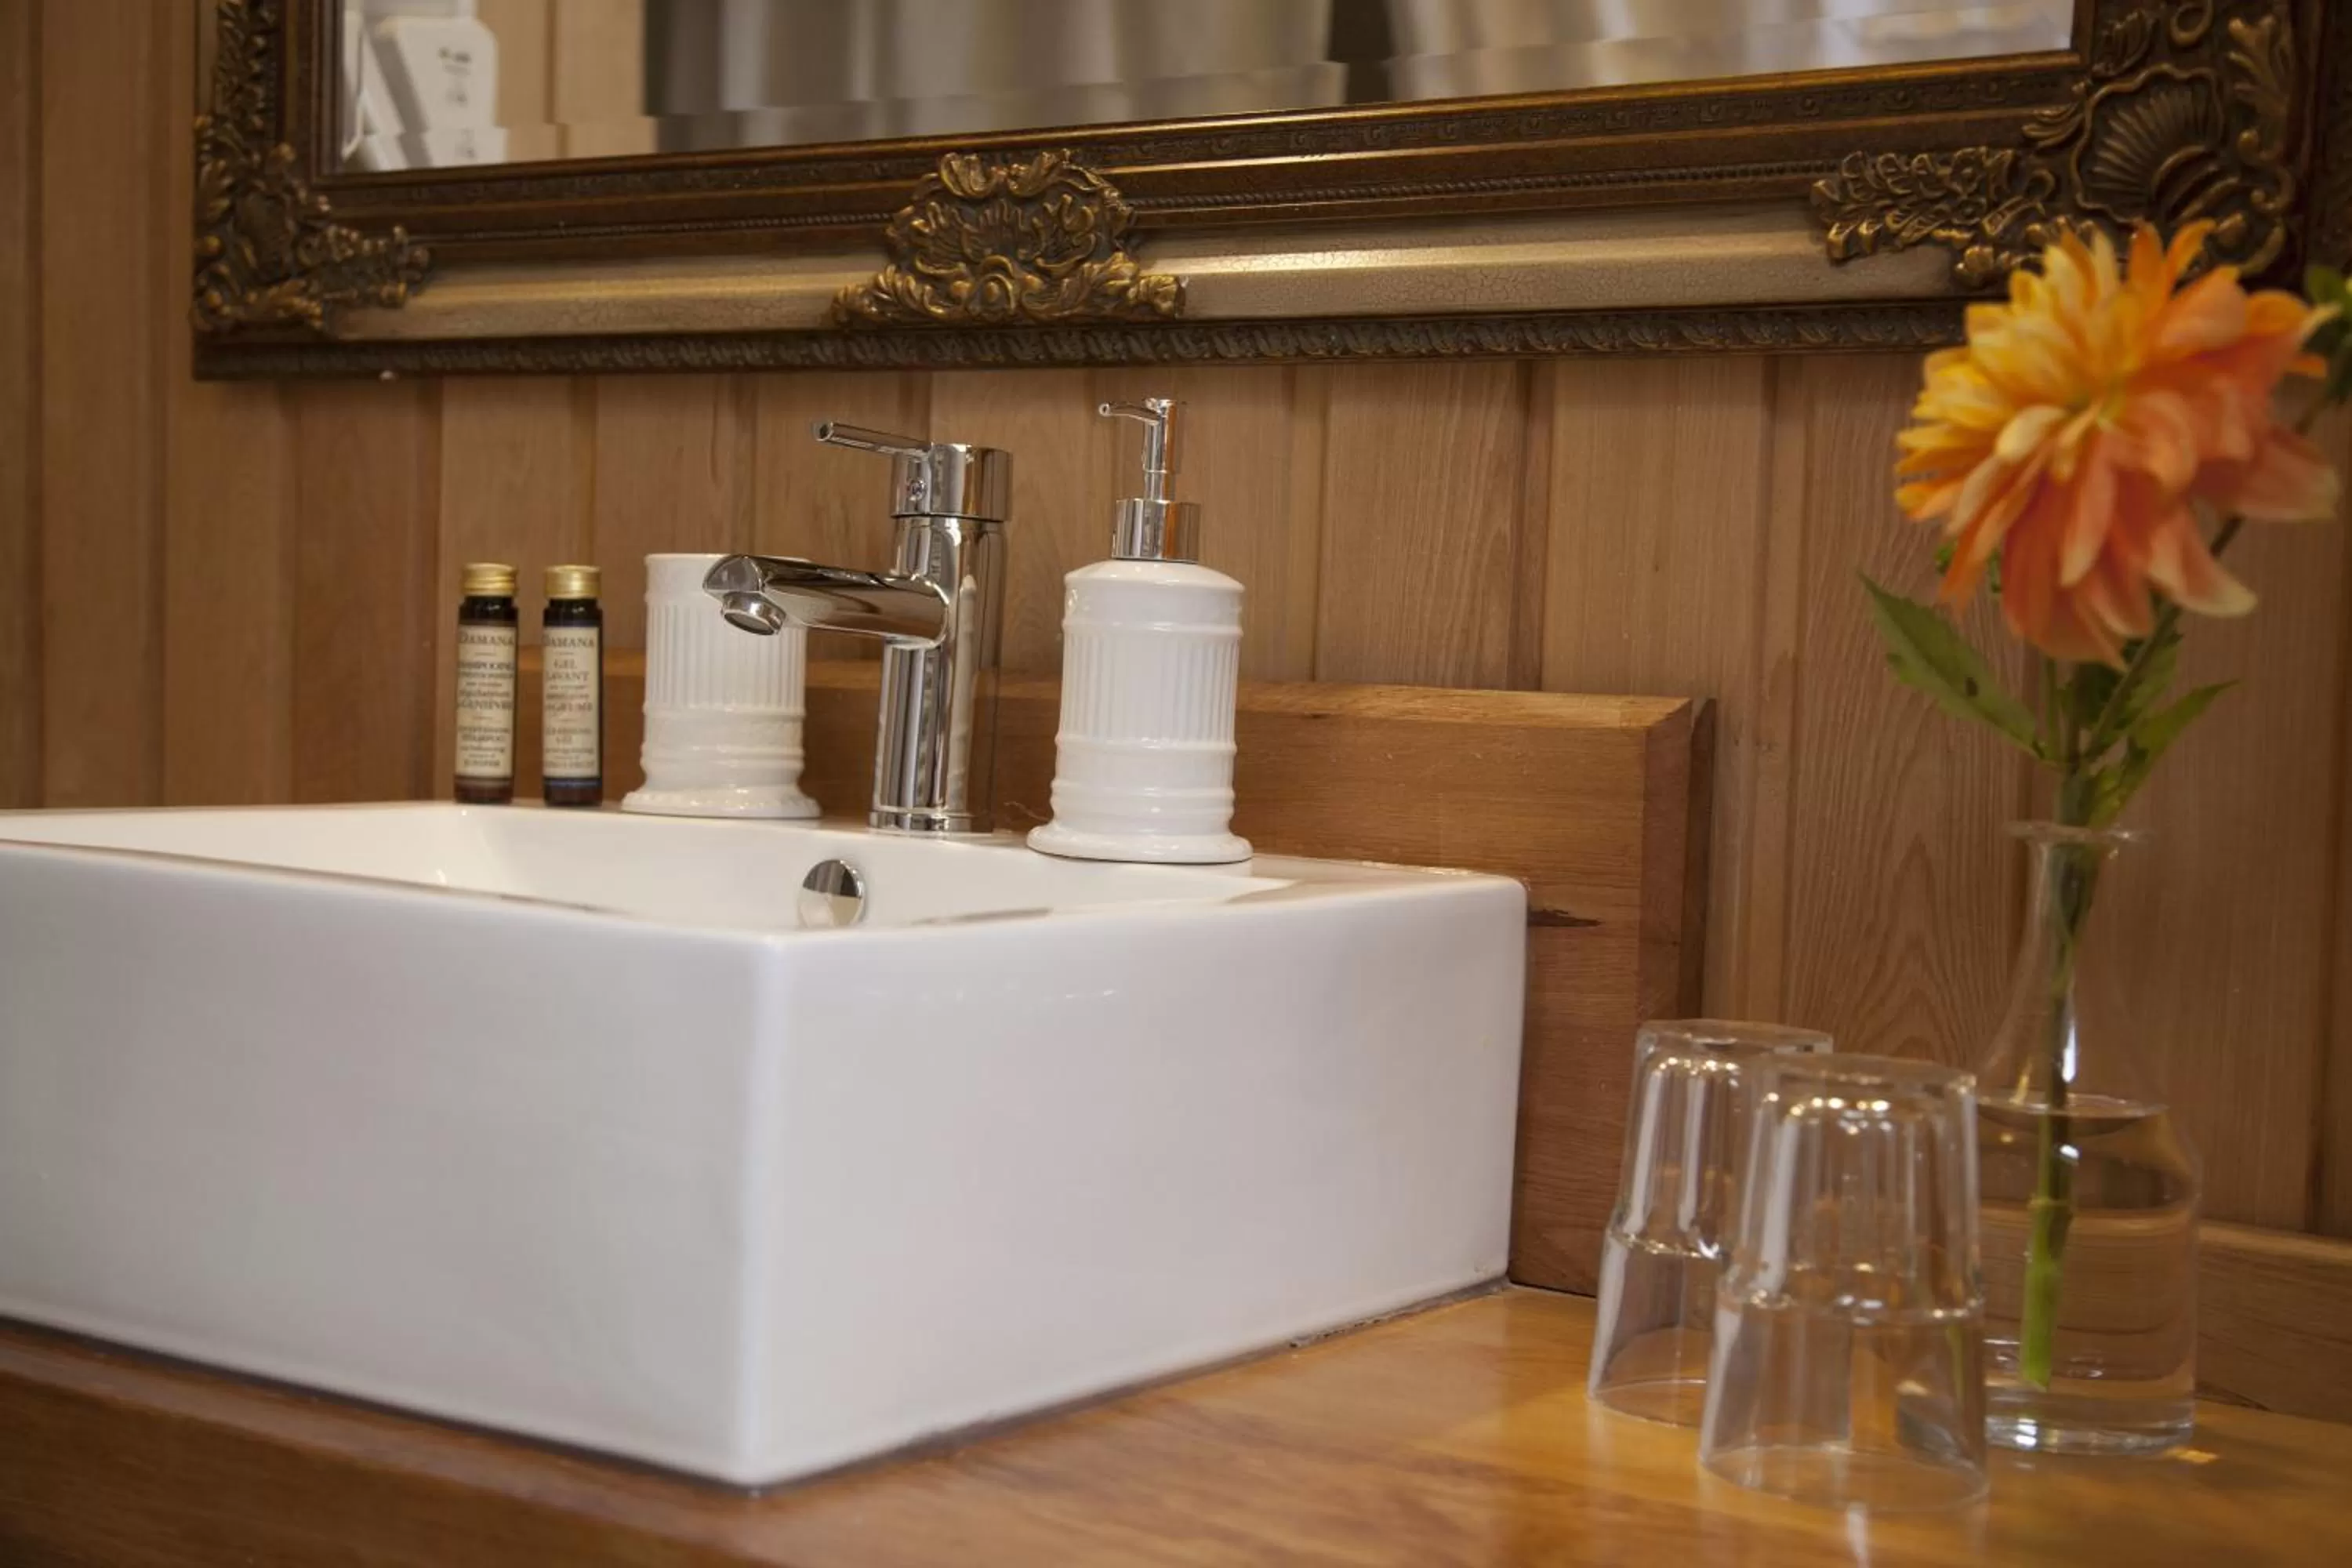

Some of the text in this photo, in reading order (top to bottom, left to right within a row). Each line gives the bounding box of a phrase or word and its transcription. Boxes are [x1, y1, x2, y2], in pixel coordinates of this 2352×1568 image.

[459, 632, 514, 646] DAMANA
[542, 633, 594, 648] DAMANA
[554, 659, 577, 669] GEL
